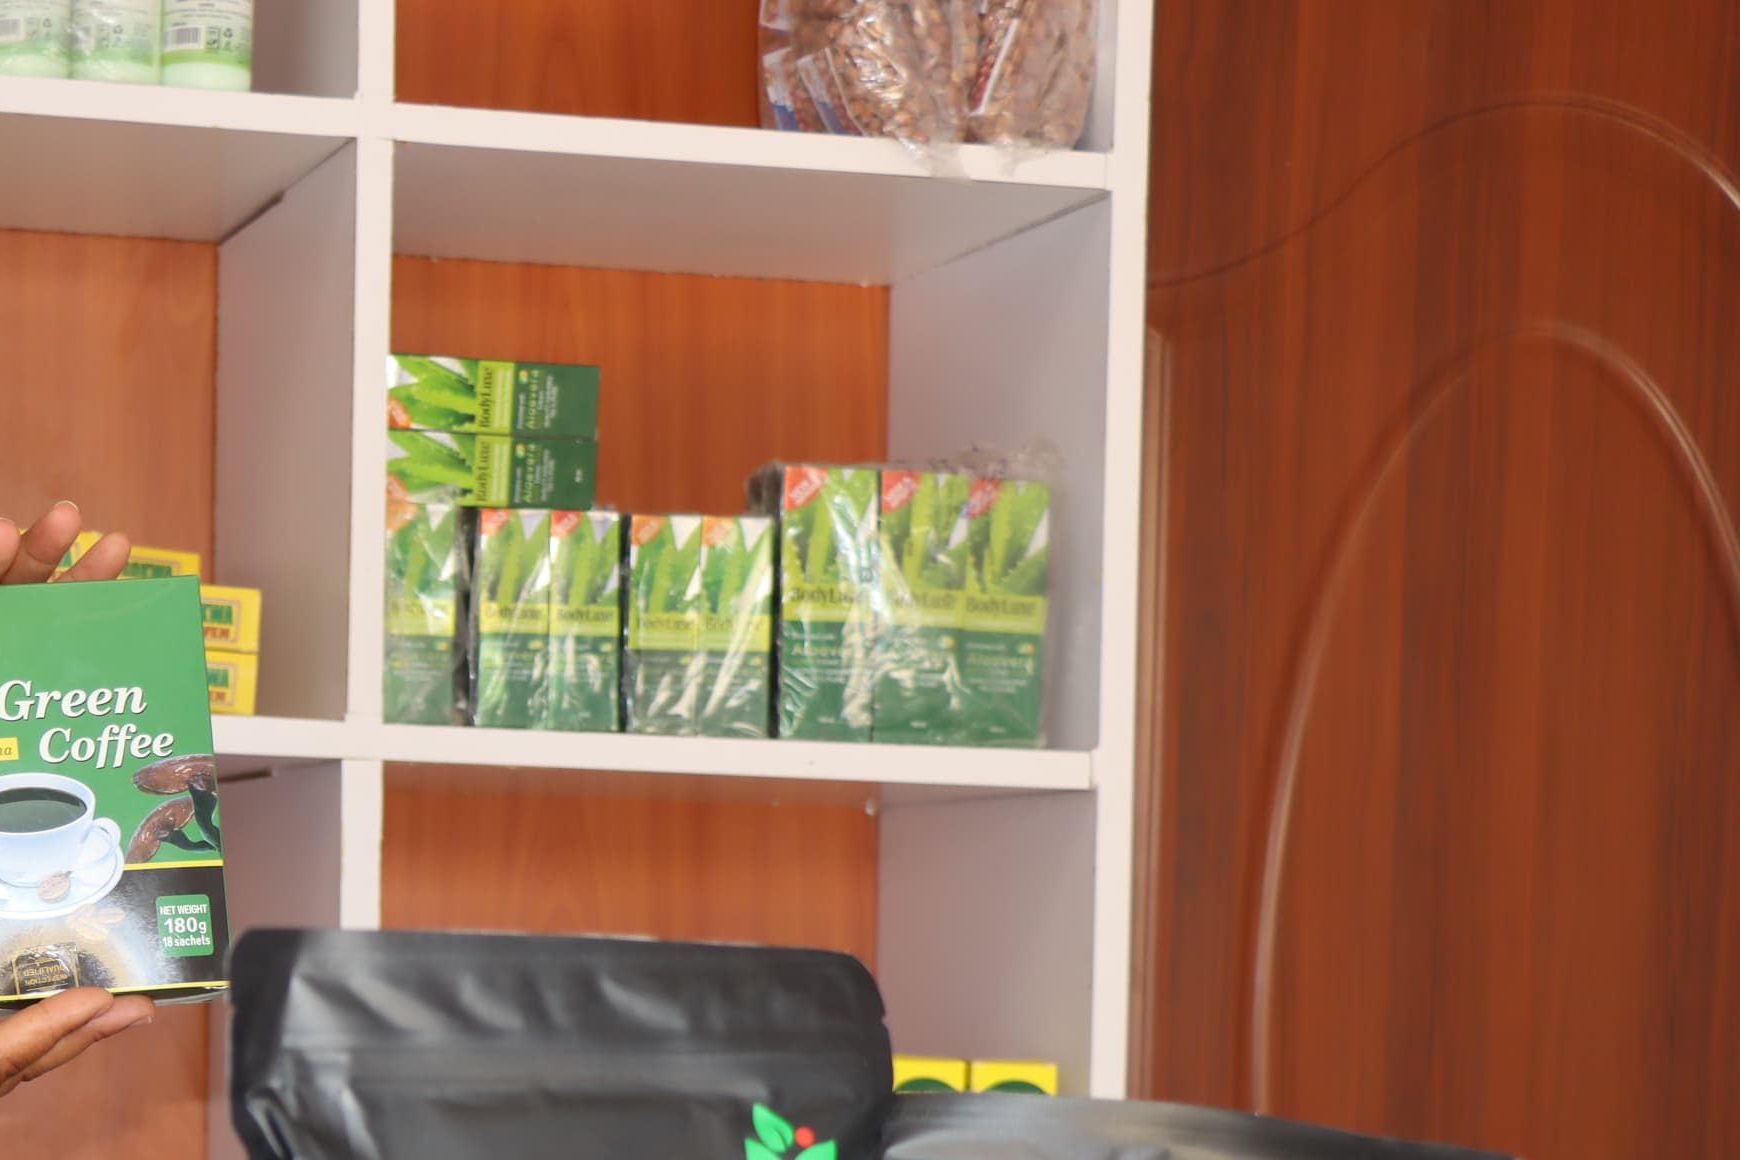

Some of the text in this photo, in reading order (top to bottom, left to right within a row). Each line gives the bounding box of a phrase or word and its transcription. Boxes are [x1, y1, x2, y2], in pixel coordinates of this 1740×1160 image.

[38, 723, 174, 769] Coffee
[160, 904, 207, 915] NET WEIGHT
[164, 917, 207, 933] 180g
[163, 935, 211, 947] 18 sachets
